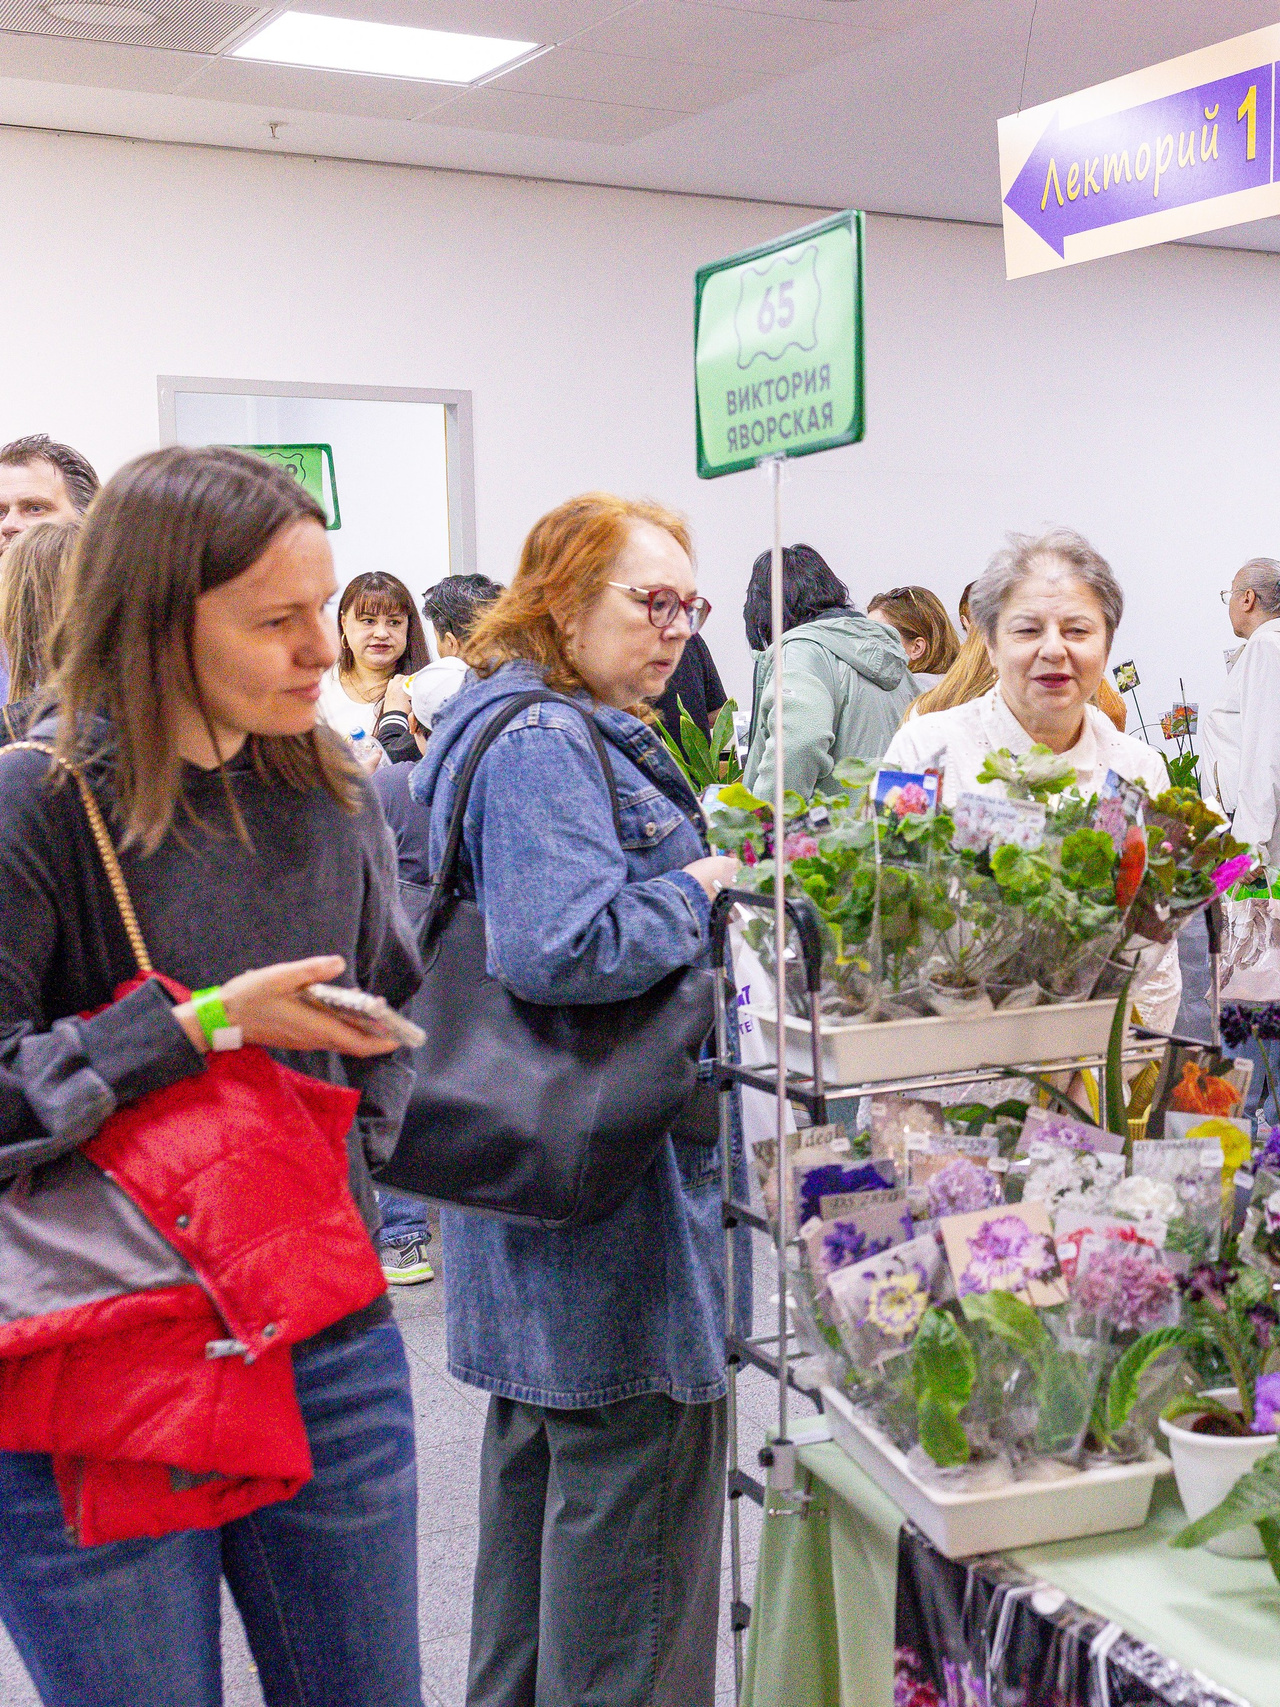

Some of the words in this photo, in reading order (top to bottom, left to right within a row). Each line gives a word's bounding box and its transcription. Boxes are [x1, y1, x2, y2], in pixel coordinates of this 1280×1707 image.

[1040, 104, 1219, 211] Лекторий
[1237, 84, 1257, 161] 1
[757, 279, 795, 334] 65
[726, 364, 831, 416] ВИКТОРИЯ
[726, 402, 834, 453] ЯВОРСКАЯ
